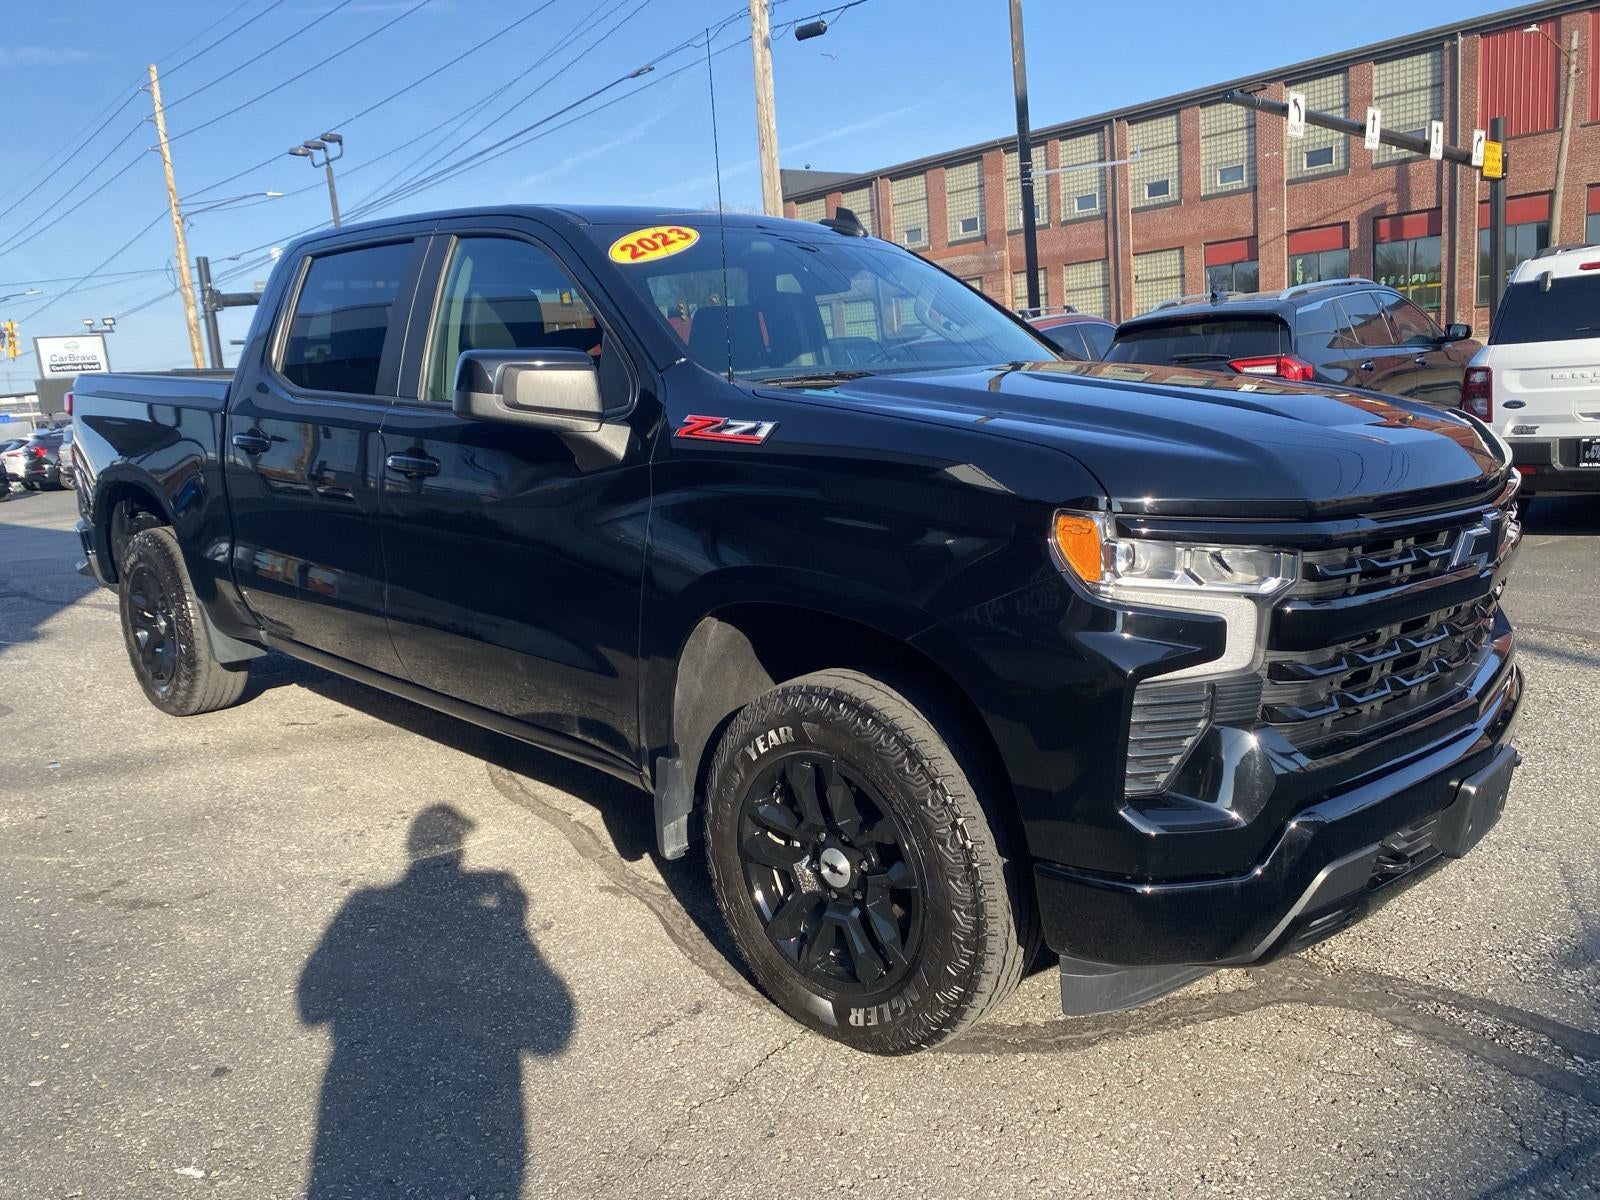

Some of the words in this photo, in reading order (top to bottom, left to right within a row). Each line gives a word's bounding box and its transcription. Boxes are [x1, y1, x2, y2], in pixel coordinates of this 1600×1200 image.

[1289, 123, 1302, 133] ONLY
[620, 228, 691, 260] 2023
[50, 353, 97, 362] CarBravo
[674, 414, 780, 445] Z71
